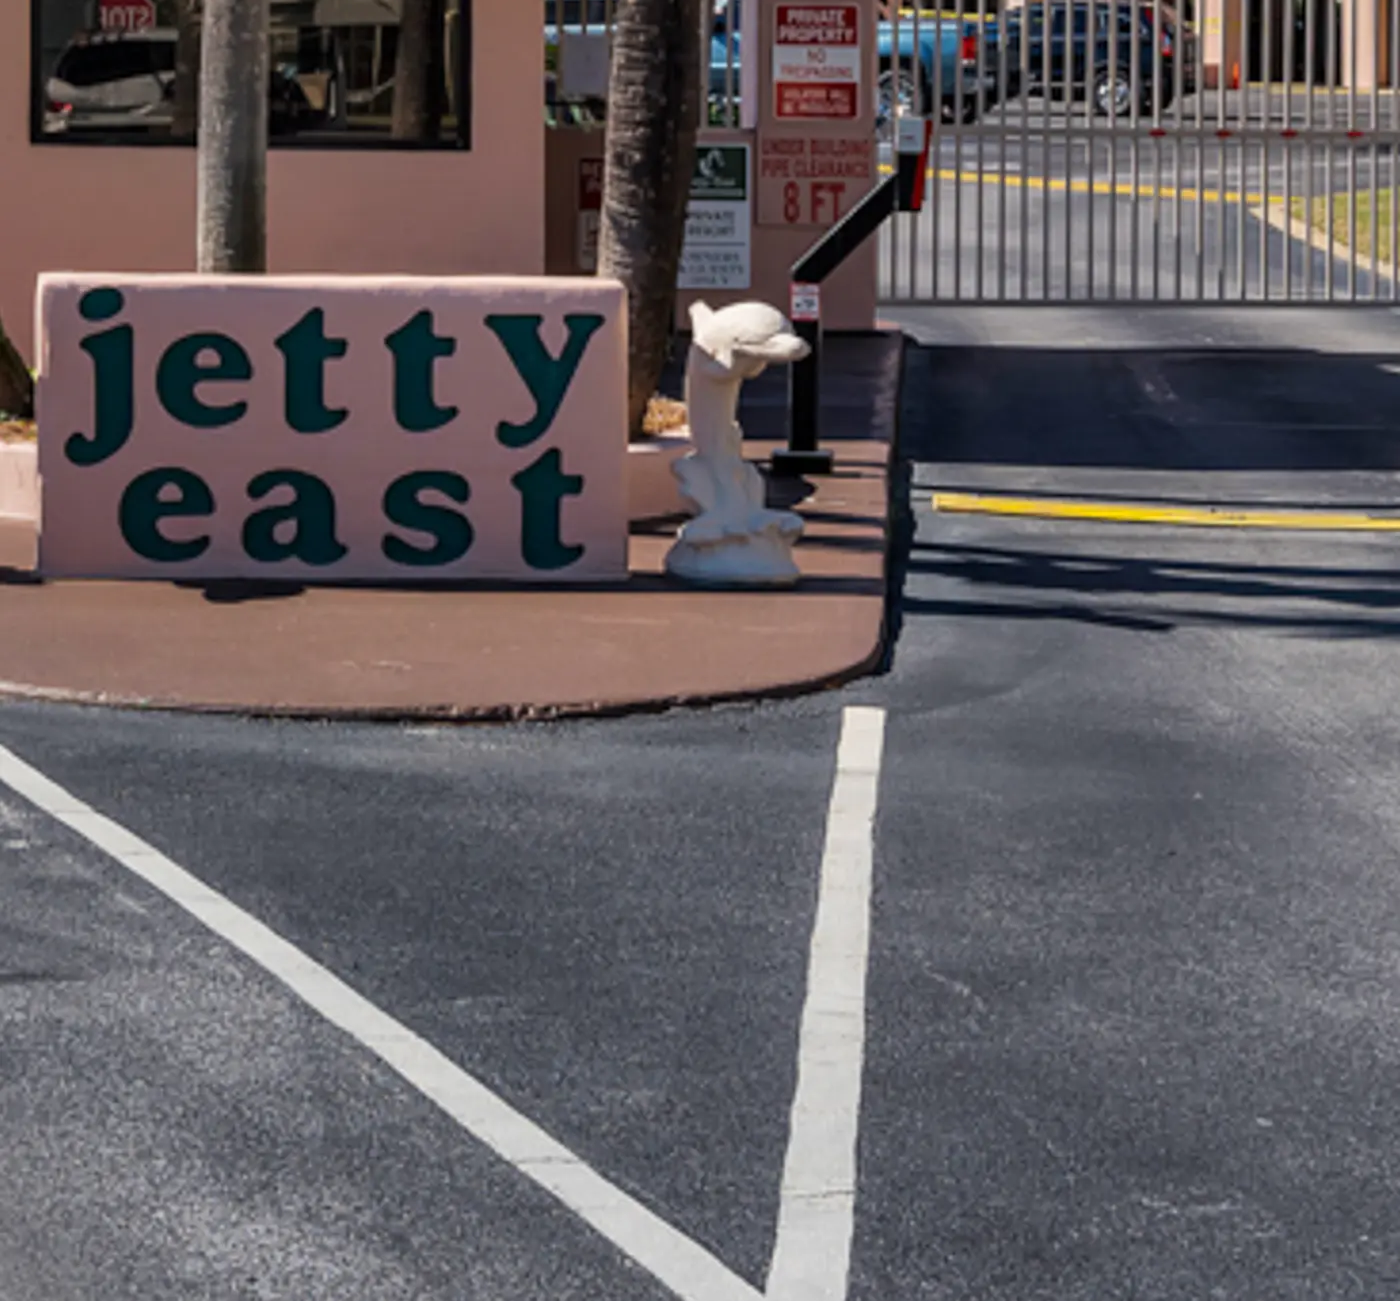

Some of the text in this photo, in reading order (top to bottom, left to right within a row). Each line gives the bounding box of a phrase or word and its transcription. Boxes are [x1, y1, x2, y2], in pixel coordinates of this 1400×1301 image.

[786, 8, 846, 26] PRIVATE
[779, 25, 855, 42] PROPERTY
[806, 47, 827, 63] NO
[779, 64, 854, 79] TRESPASSING
[761, 138, 870, 156] UNDER BUILDING
[761, 158, 870, 178] PIPE CLEARANCE
[783, 180, 846, 223] 8 FT
[64, 286, 605, 466] jetty
[118, 447, 586, 570] east
